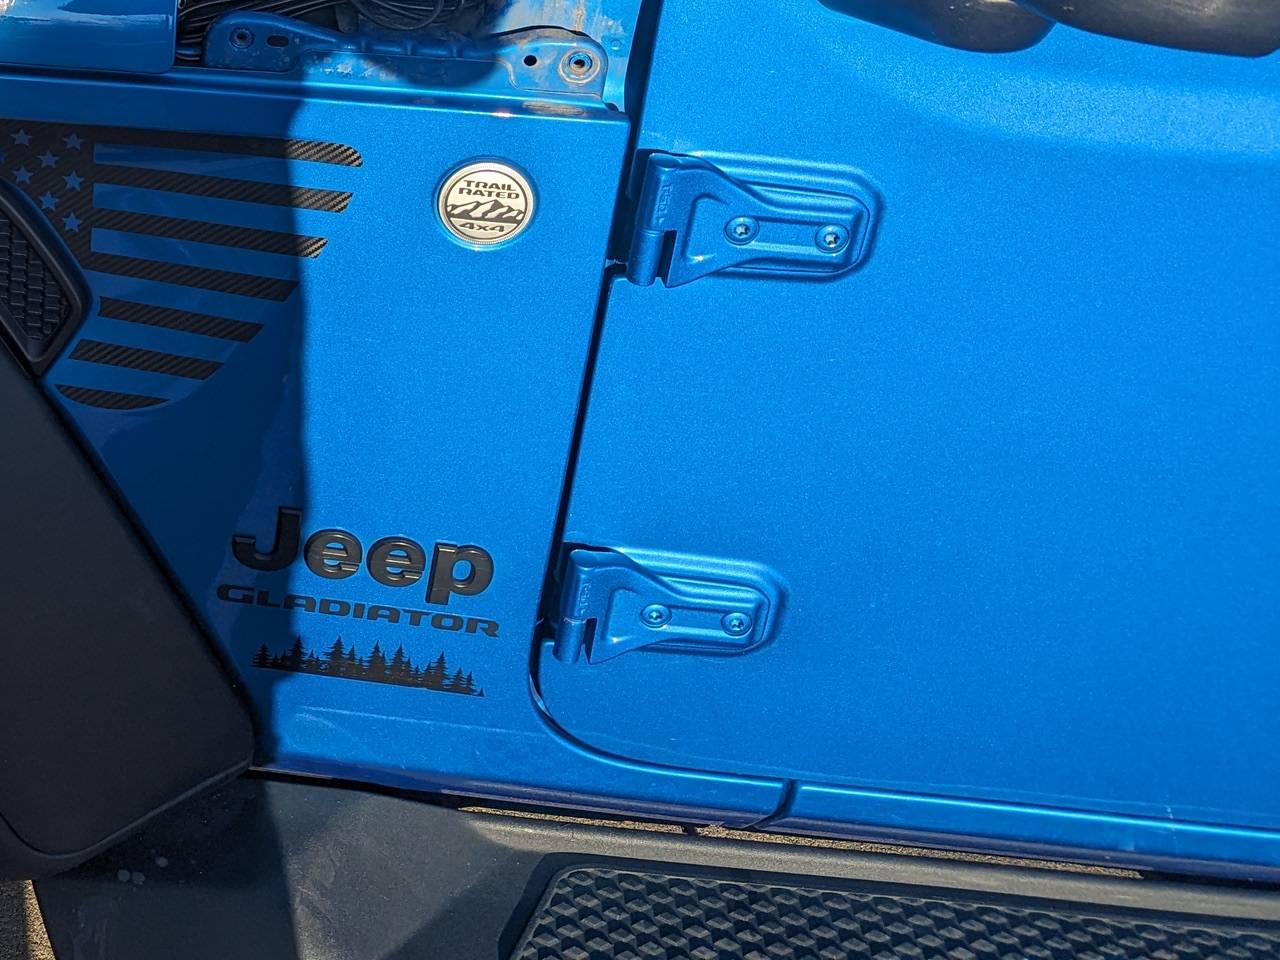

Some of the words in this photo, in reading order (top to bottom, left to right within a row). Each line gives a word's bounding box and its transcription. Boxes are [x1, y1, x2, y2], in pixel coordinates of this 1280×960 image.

[463, 179, 516, 191] TRAIL
[458, 187, 520, 199] RATED
[458, 222, 505, 233] 4x4
[231, 506, 494, 606] Jeep
[216, 583, 500, 638] GLADIATOR
